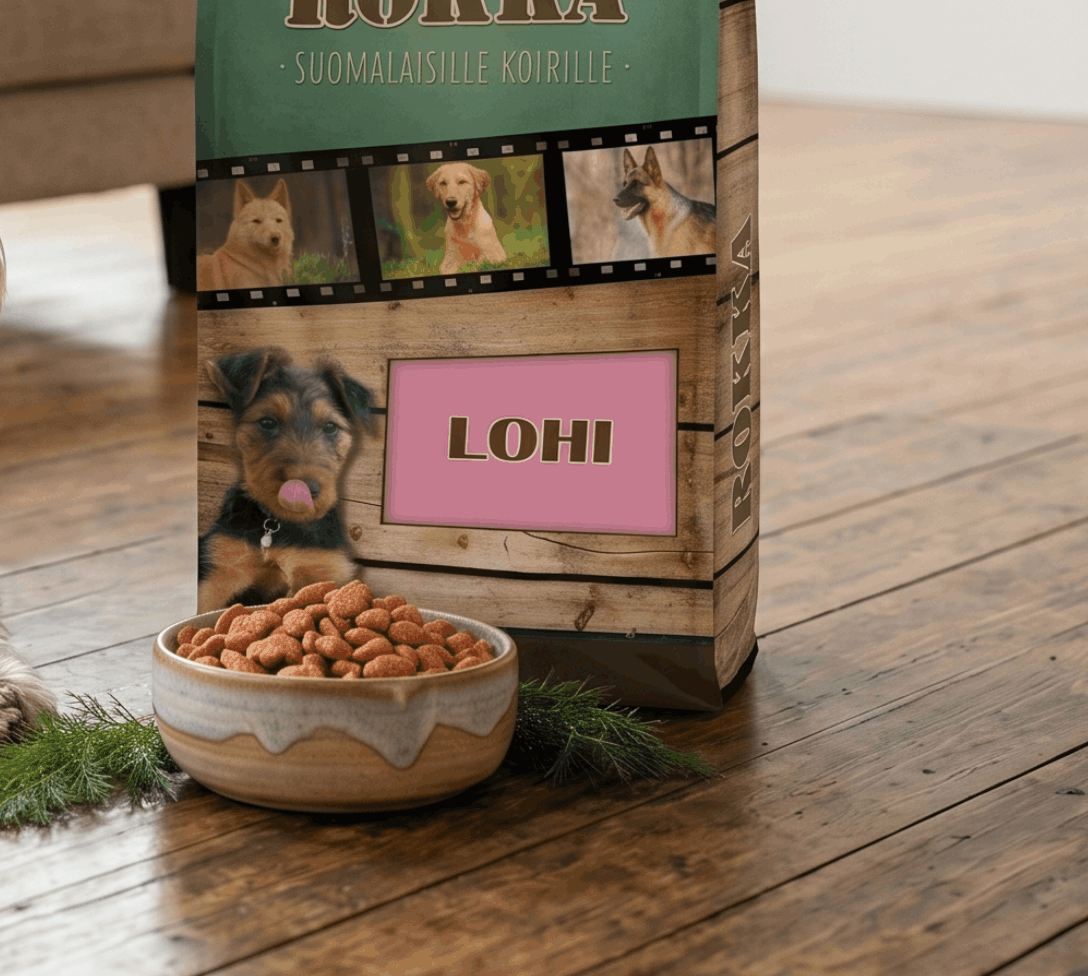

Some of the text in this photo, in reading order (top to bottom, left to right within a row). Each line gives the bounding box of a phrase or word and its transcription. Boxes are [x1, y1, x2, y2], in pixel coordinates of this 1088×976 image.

[295, 50, 613, 85] SUOMALAISILLE KOIRILLE
[731, 213, 752, 536] ROKKA
[447, 415, 614, 465] LOHI
